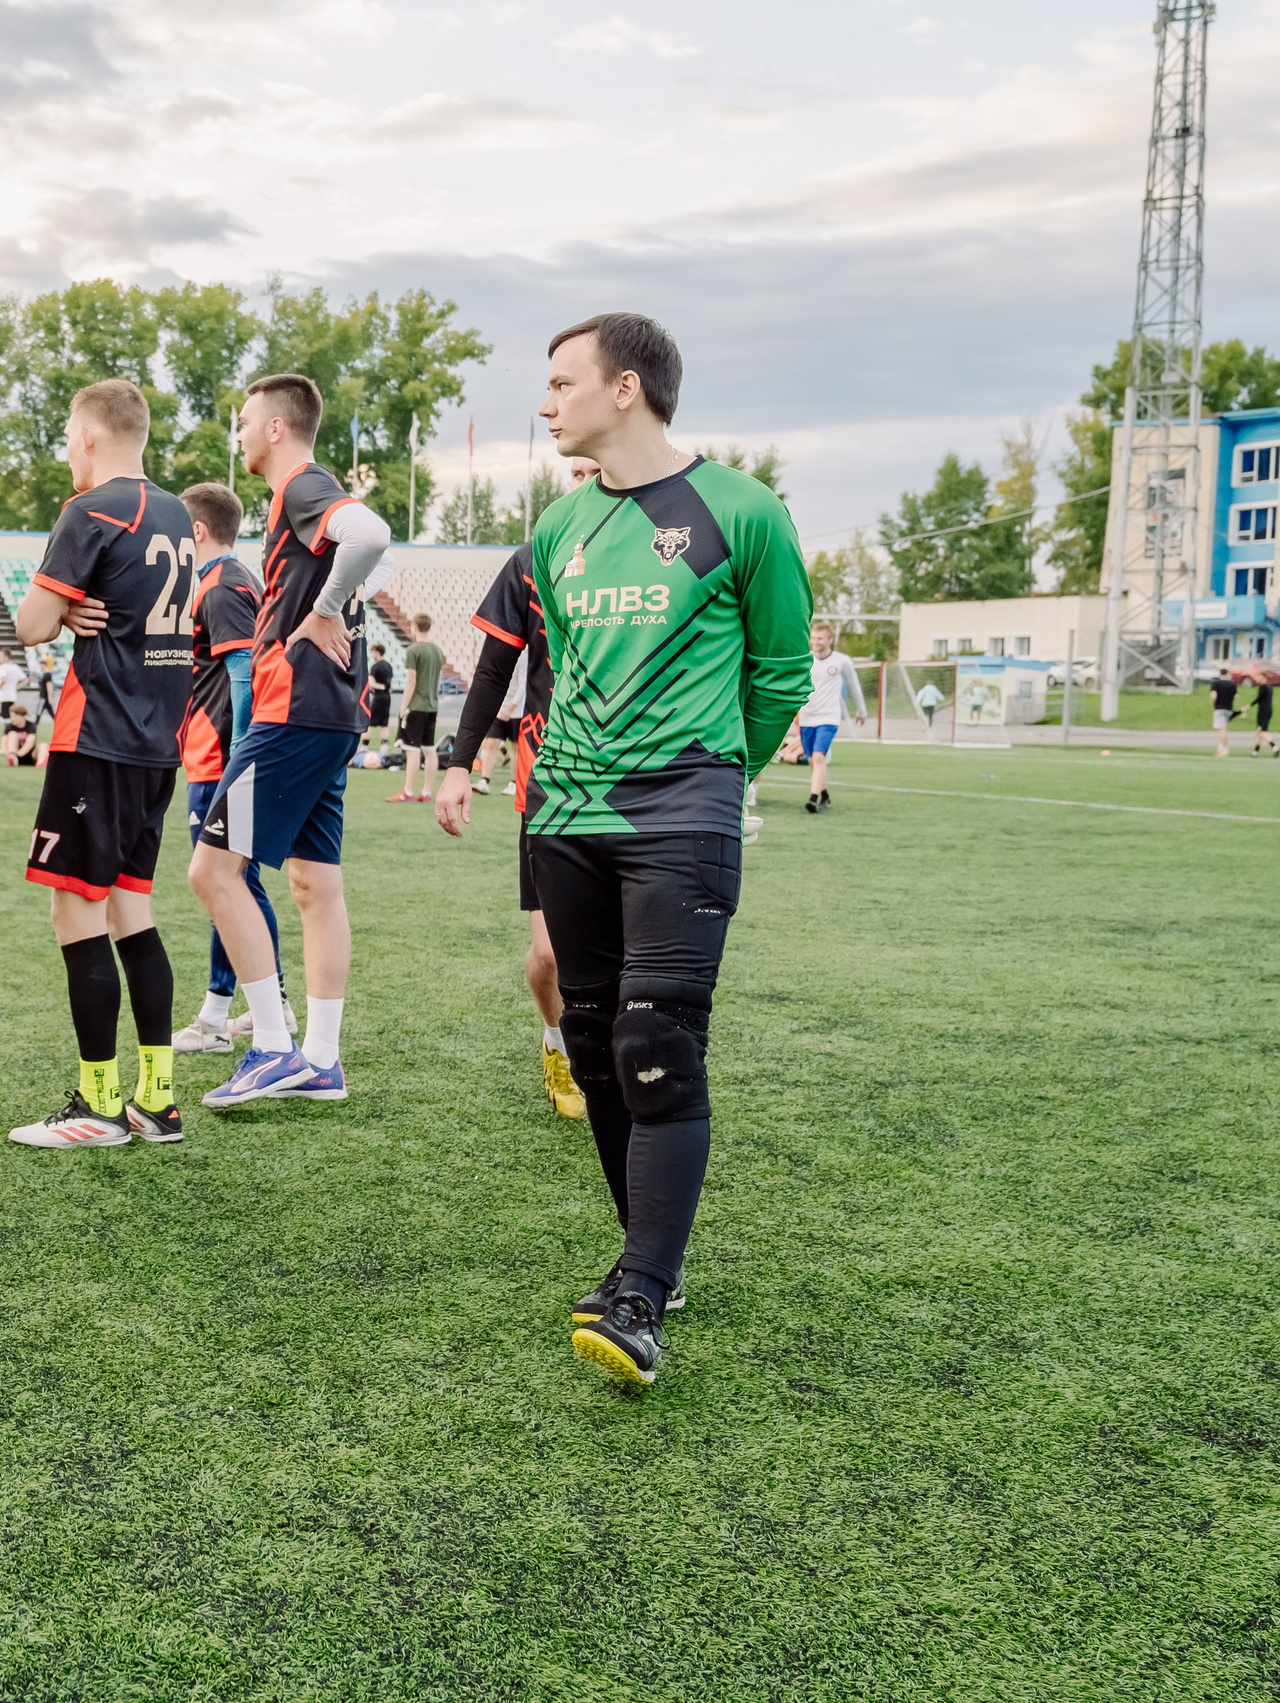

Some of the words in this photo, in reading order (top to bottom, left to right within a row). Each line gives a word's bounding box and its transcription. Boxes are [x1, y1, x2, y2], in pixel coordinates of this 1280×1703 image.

[145, 534, 196, 635] 22
[566, 584, 670, 617] НЛВЗ
[570, 616, 625, 629] КРЕПОСТЬ
[630, 615, 667, 626] ДУХА
[28, 828, 60, 863] 17
